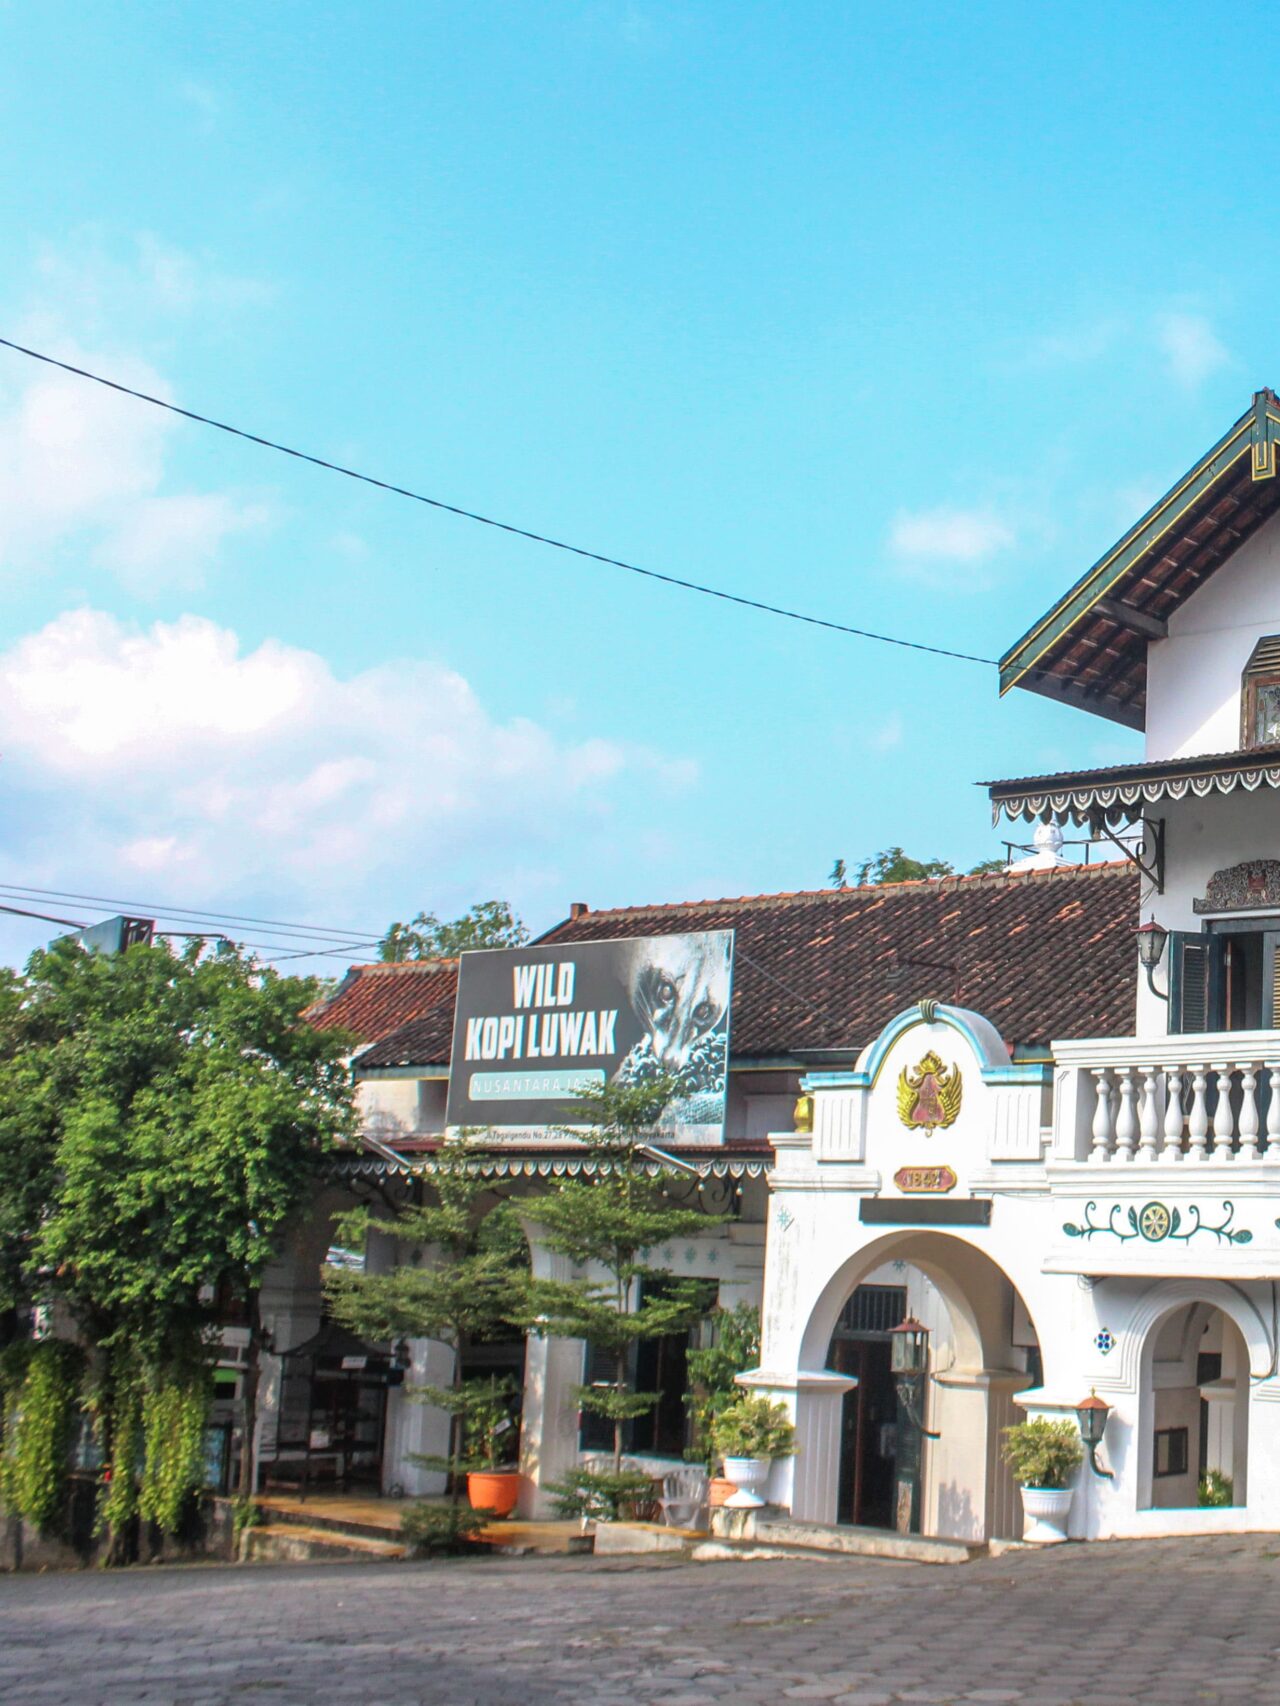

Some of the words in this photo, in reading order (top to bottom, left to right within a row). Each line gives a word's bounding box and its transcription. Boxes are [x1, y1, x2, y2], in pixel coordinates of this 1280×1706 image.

[513, 962, 575, 1009] WILD
[465, 1015, 525, 1061] KOPI
[527, 1009, 618, 1057] LUWAK
[473, 1079, 560, 1094] NUSANTARA
